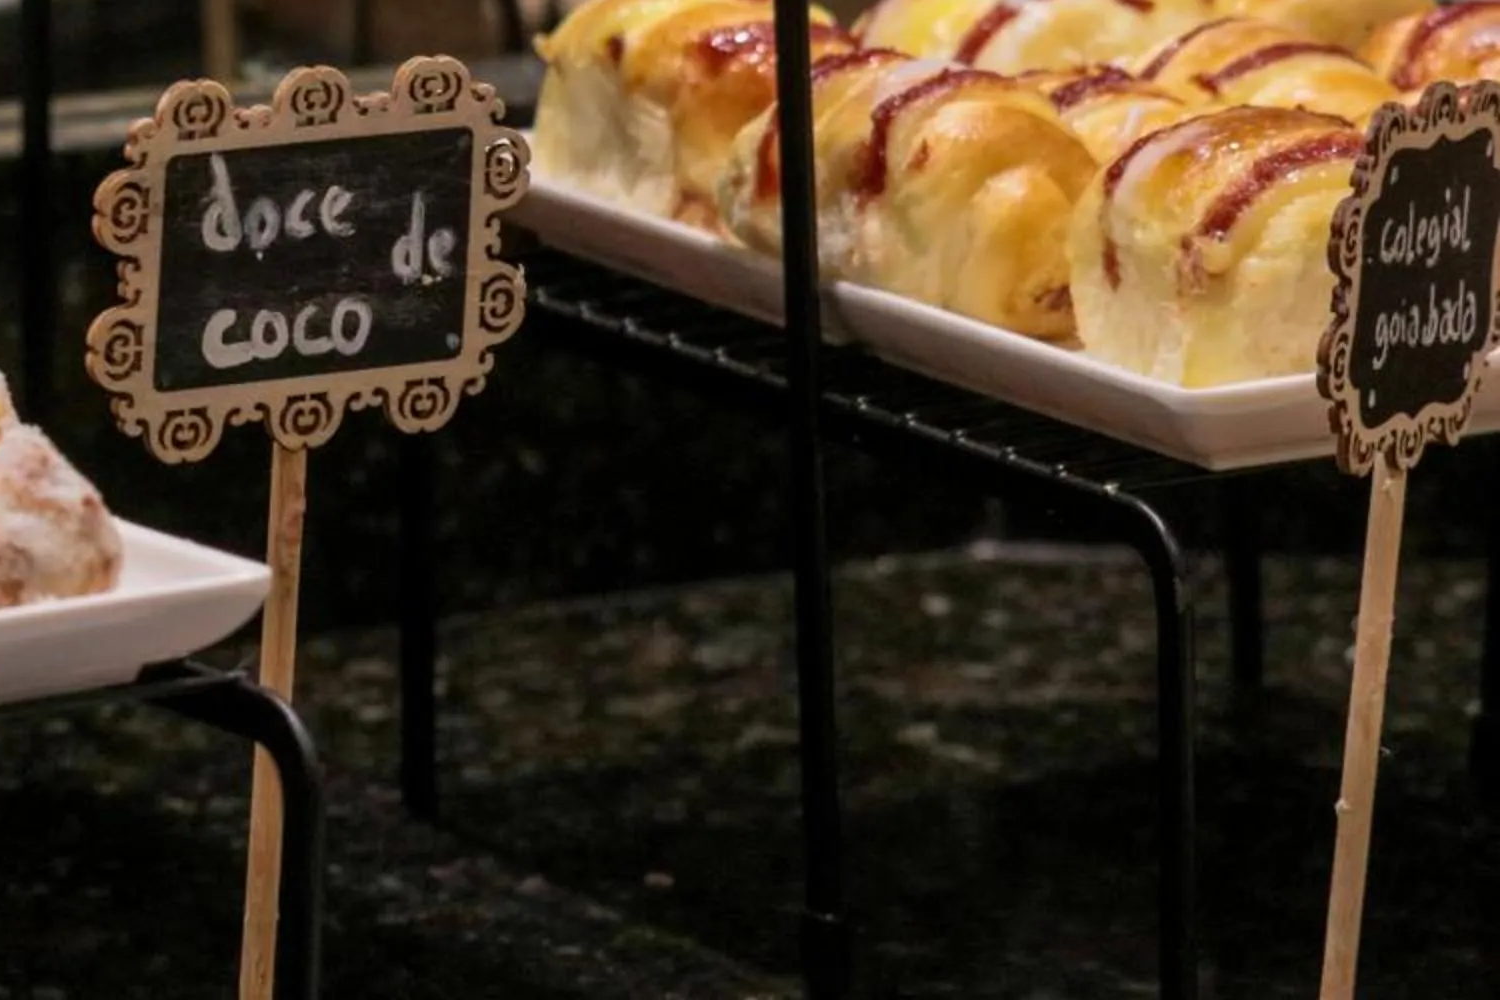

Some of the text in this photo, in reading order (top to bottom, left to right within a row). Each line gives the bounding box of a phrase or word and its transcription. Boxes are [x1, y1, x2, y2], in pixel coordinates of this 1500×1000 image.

[202, 151, 456, 285] doce de
[1372, 280, 1477, 370] goiabada
